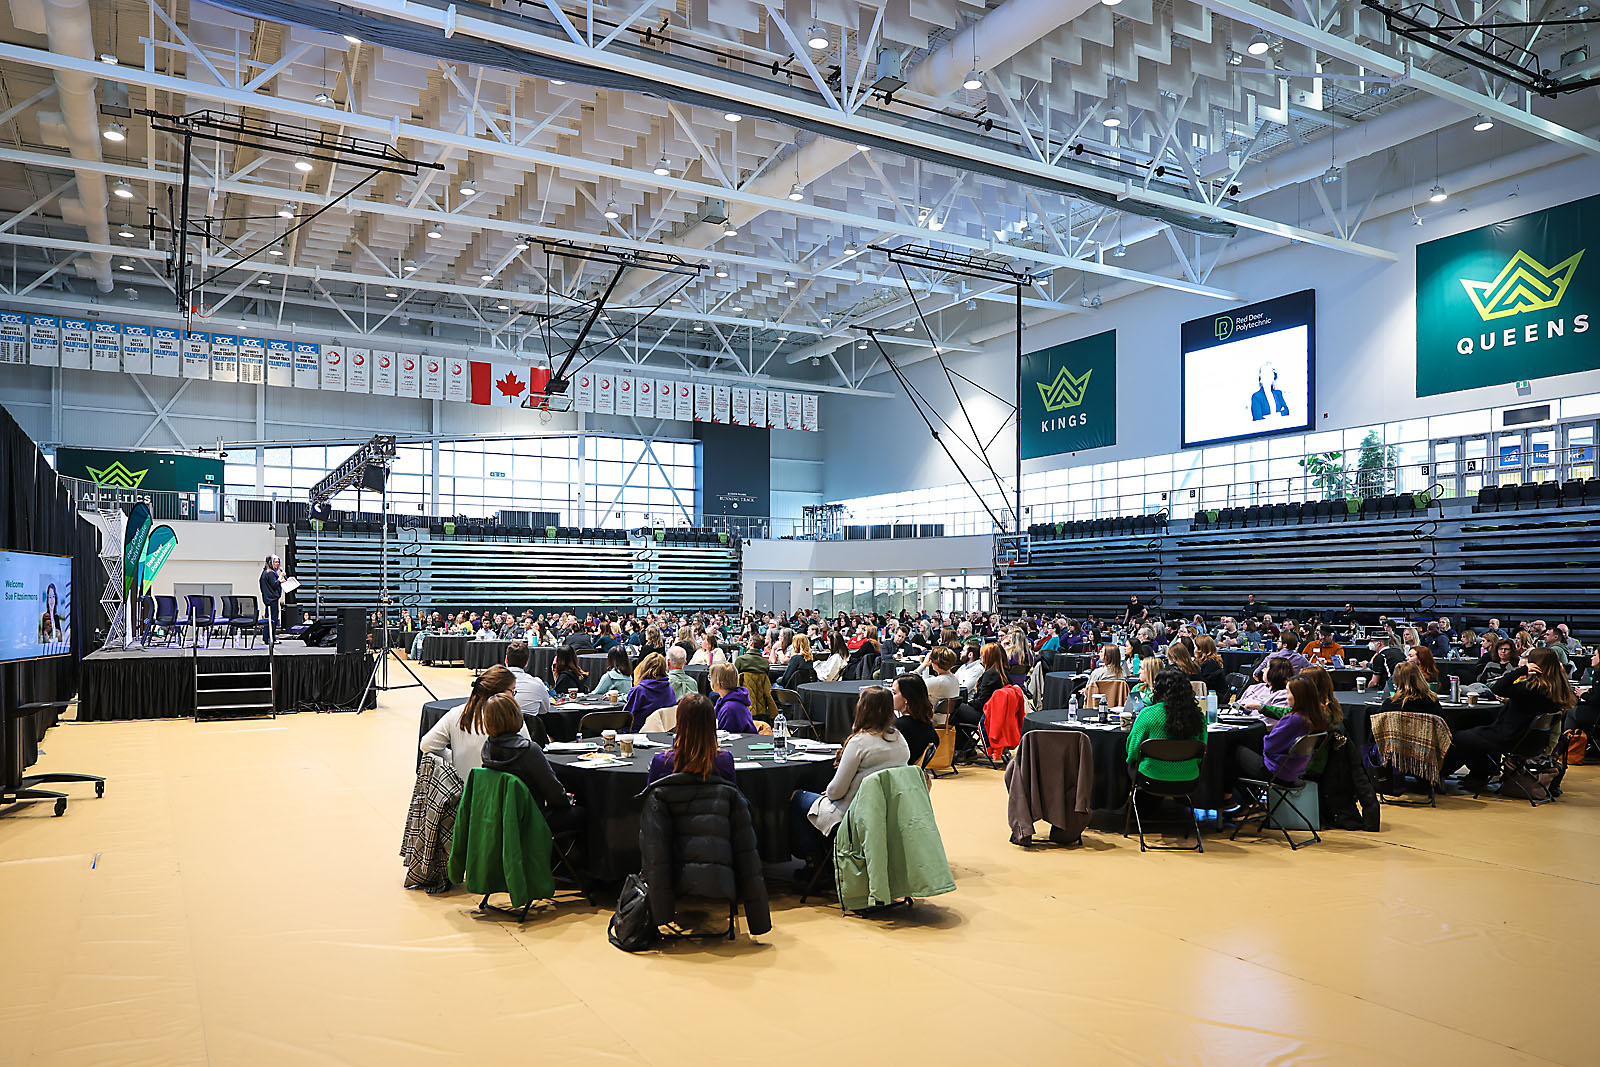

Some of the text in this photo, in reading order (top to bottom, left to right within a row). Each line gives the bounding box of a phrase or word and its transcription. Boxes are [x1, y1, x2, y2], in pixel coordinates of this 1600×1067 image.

[1235, 313, 1264, 325] Red Deer
[1235, 318, 1272, 332] Polytechnic
[1456, 314, 1589, 355] QUEENS
[31, 337, 58, 345] CHAMPIONS
[93, 343, 119, 351] CHAMPIONS
[124, 346, 149, 354] CHAMPIONS
[184, 351, 208, 360] CHAMPIONS
[295, 362, 318, 370] CHAMPIONS
[1041, 413, 1087, 433] KINGS
[1422, 467, 1428, 475] B
[132, 528, 140, 545] Deer
[130, 525, 147, 565] Polytechnic
[146, 544, 163, 567] Red Deer
[151, 543, 171, 572] Polytechnic
[5, 580, 24, 588] Welcome
[5, 592, 38, 601] Sue Fitzsimmons
[1134, 696, 1140, 704] 2
